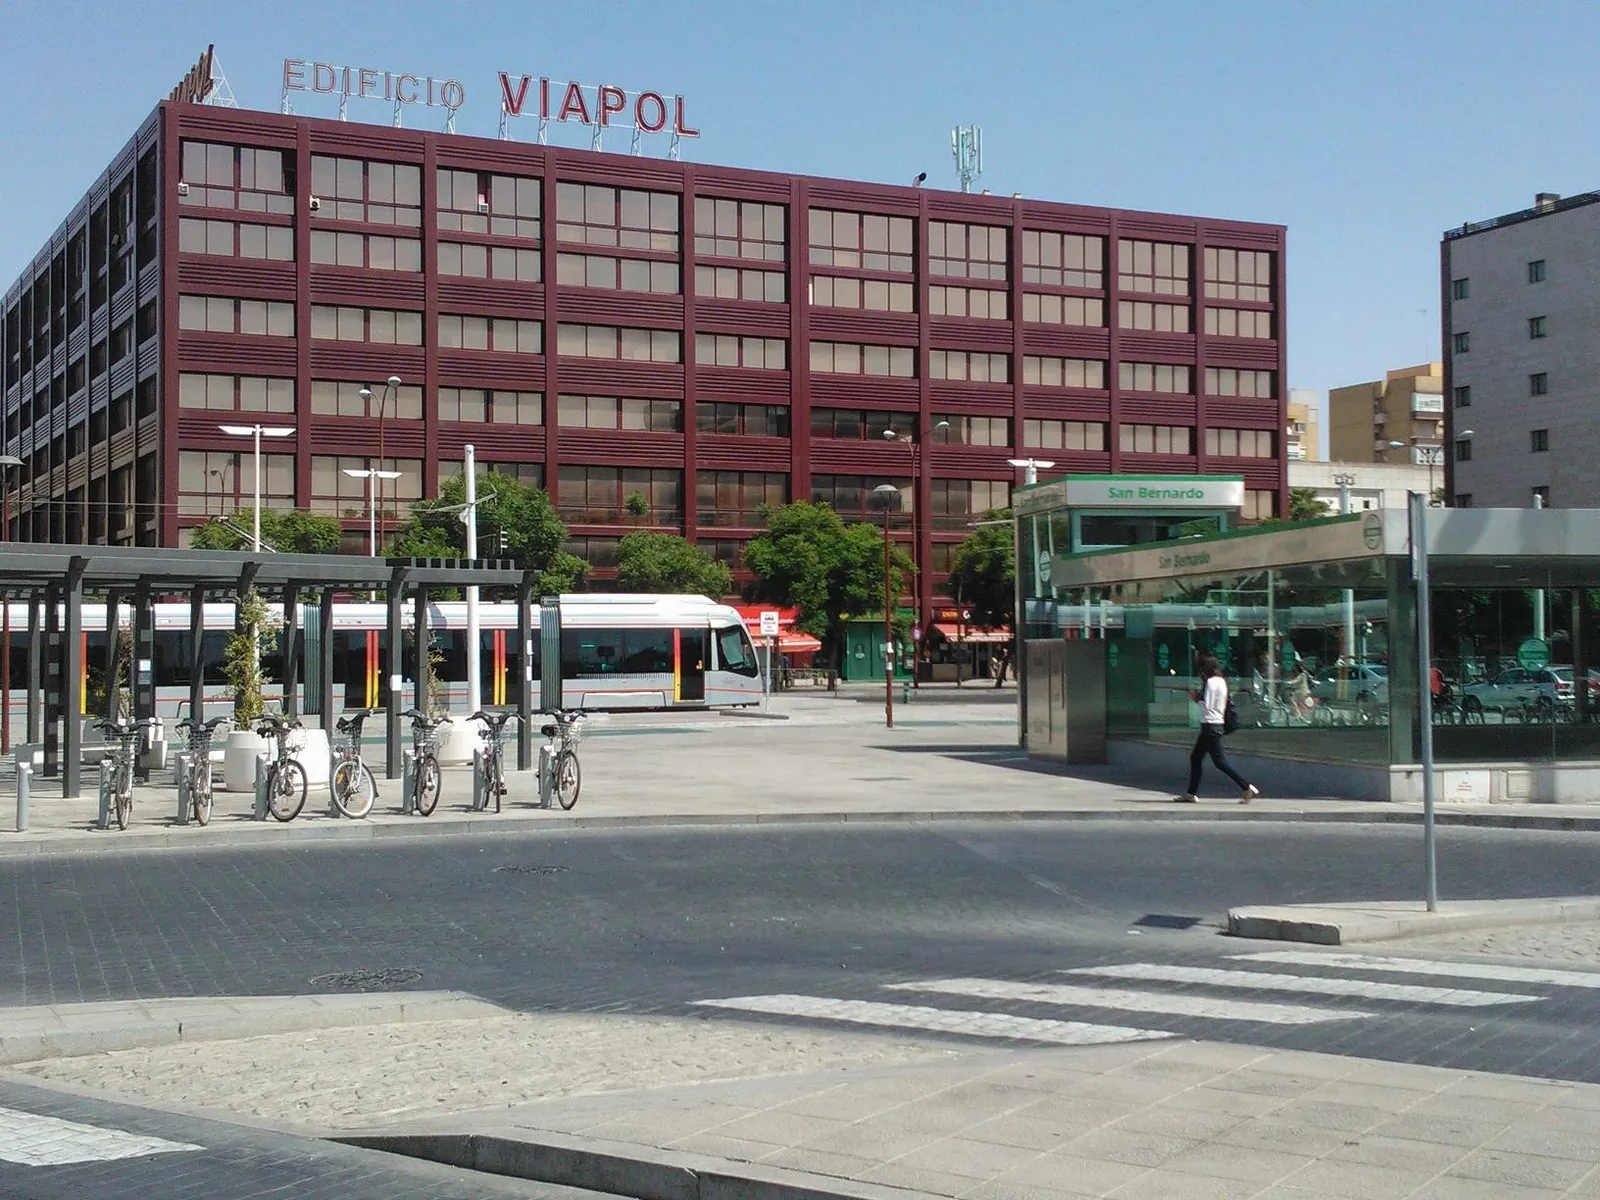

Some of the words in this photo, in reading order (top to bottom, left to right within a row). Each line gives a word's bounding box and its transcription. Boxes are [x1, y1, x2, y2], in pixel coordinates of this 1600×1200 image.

[284, 58, 465, 110] EDIFICIO
[498, 71, 700, 138] VIAPOL
[1108, 487, 1133, 499] San
[1140, 487, 1204, 499] Bernardo
